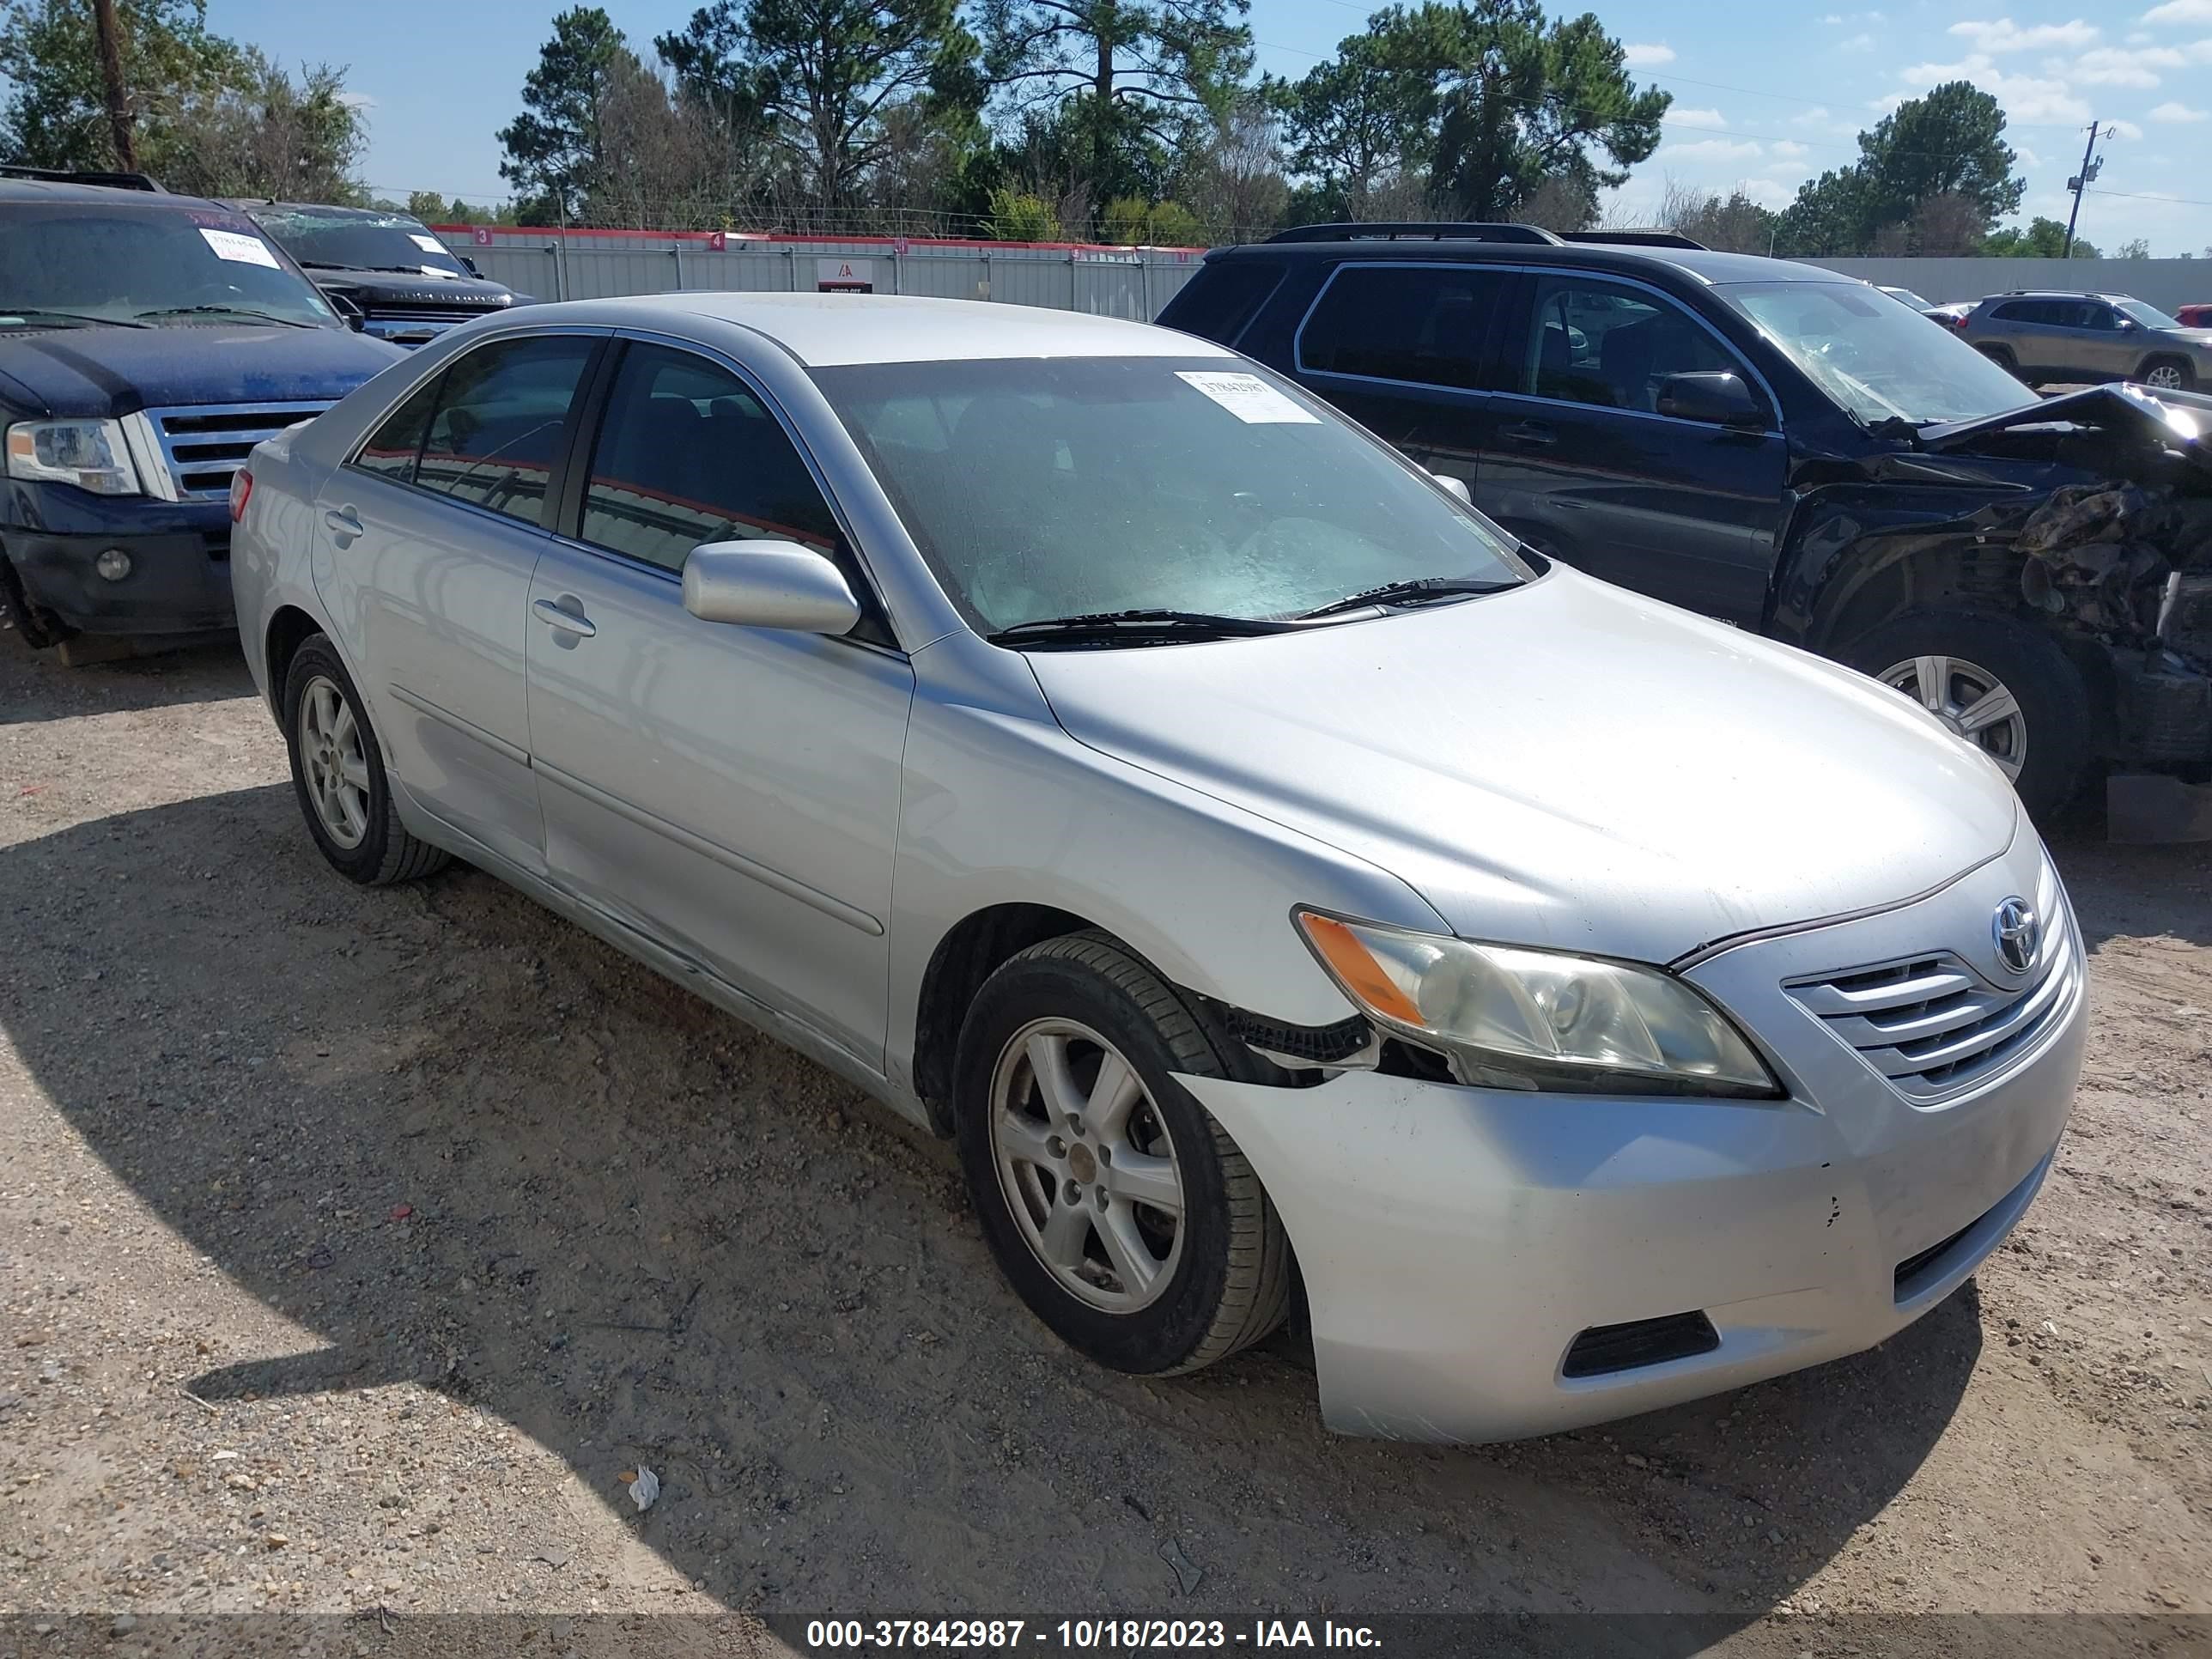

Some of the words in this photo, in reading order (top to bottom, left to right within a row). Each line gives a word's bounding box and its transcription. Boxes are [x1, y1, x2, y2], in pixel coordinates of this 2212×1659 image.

[478, 229, 488, 244] 3
[713, 234, 721, 247] 4
[1200, 382, 1269, 393] 37842987
